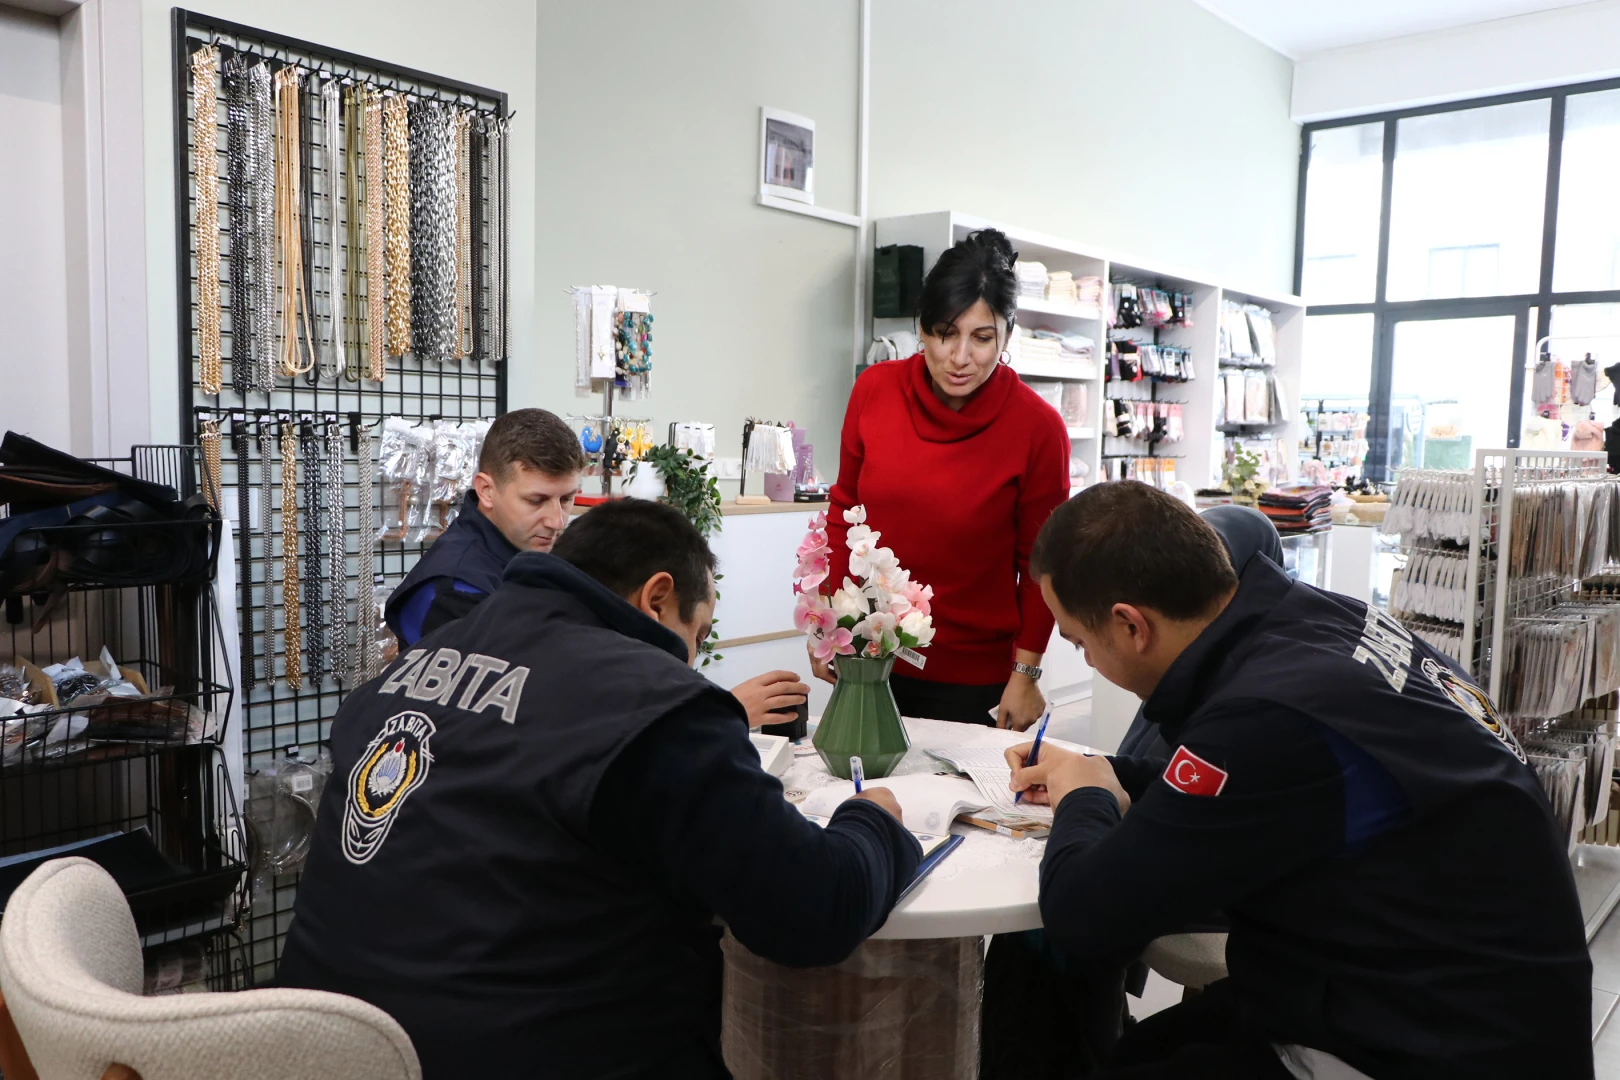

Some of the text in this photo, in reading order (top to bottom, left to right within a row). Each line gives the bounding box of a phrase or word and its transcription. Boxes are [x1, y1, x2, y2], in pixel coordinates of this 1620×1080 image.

[378, 648, 531, 725] ZABITA
[1352, 604, 1414, 694] ZABIT
[387, 715, 429, 742] ZABITA
